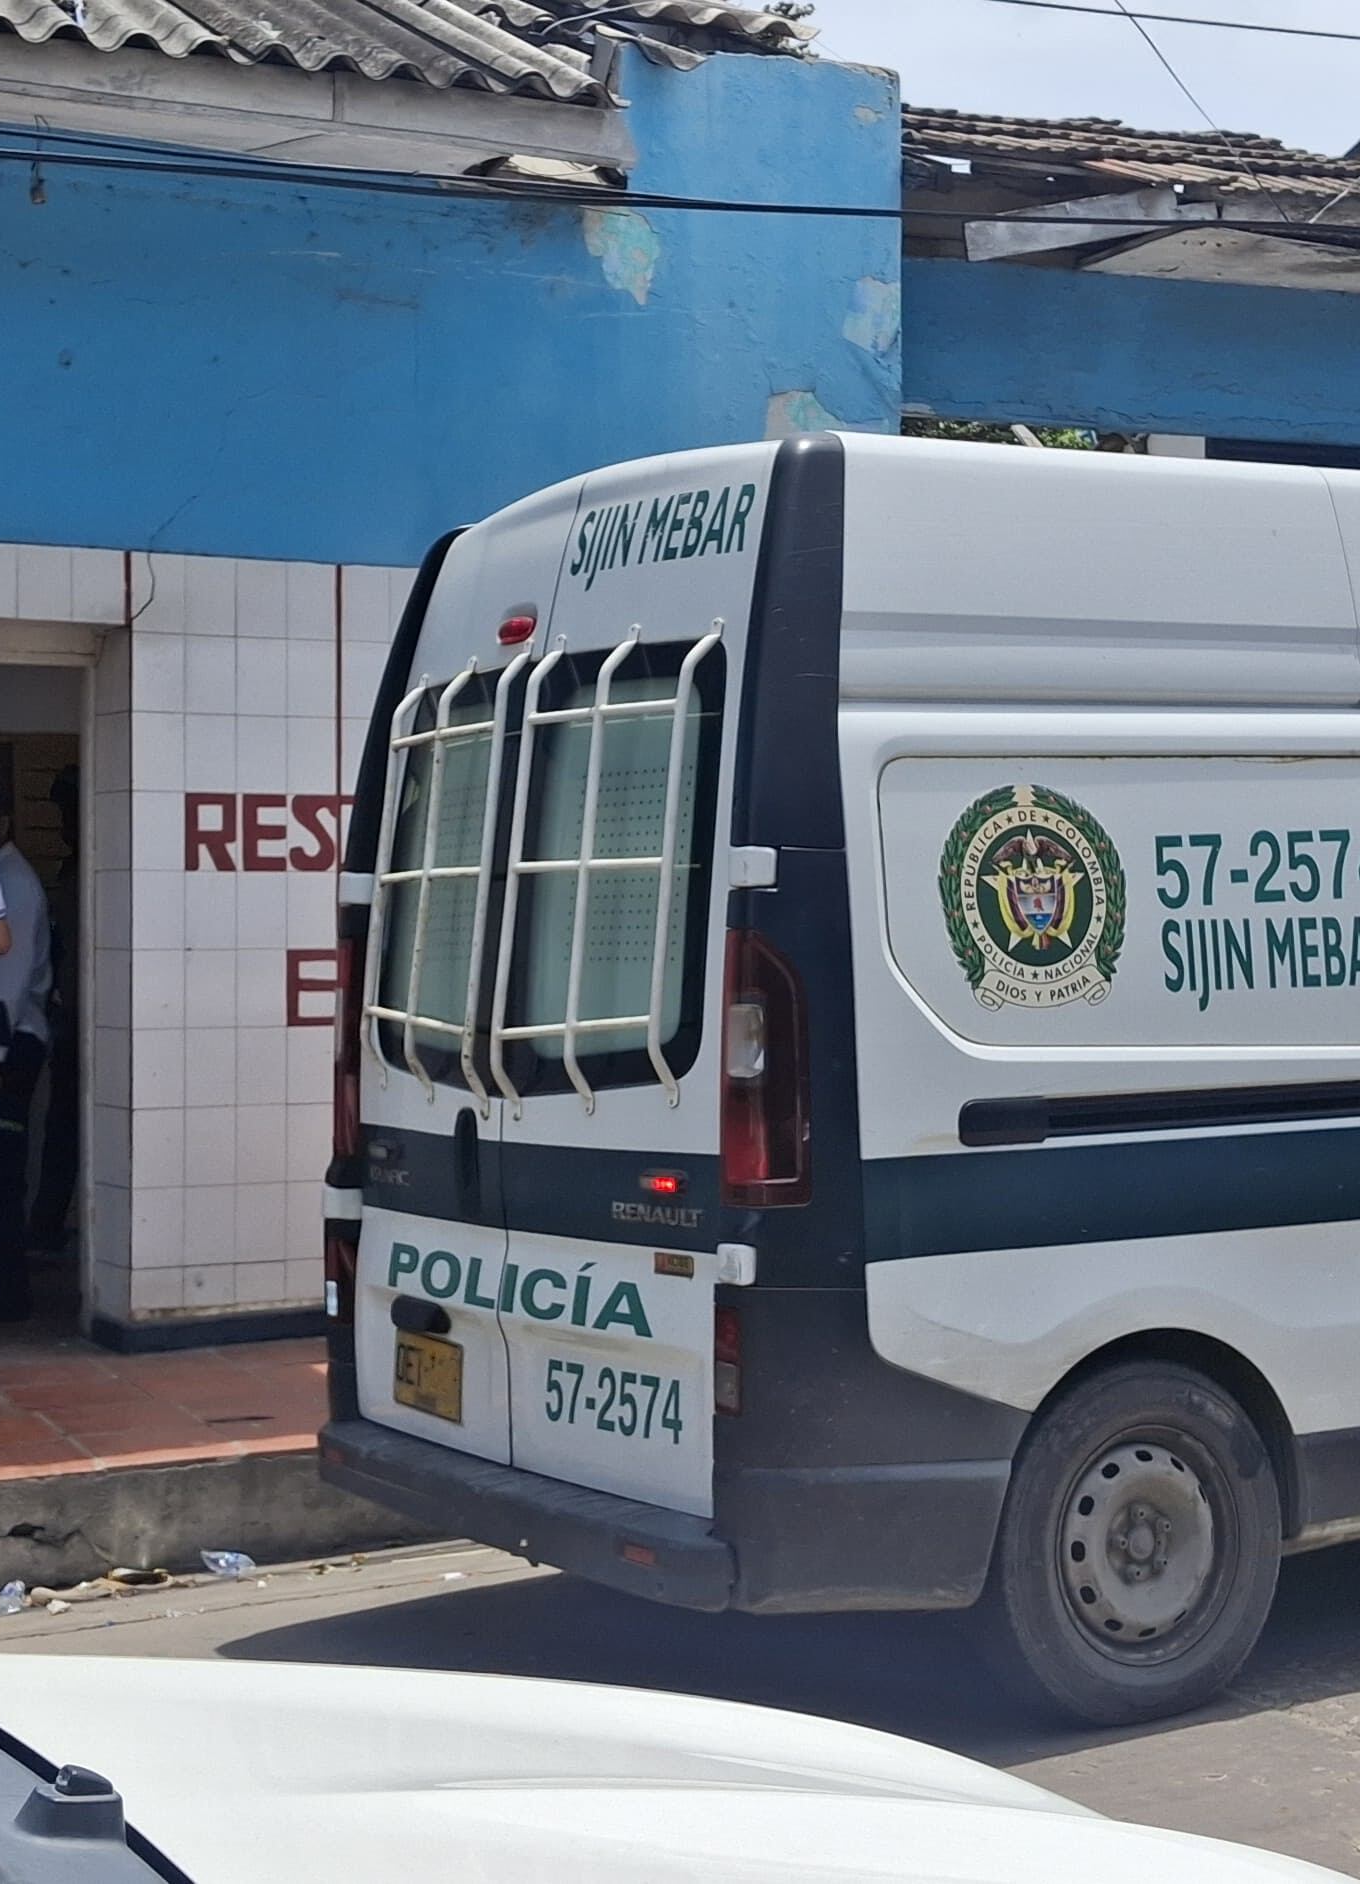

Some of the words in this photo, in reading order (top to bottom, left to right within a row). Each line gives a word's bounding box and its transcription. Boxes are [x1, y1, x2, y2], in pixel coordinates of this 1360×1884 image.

[570, 501, 643, 591] SIJIN
[638, 484, 755, 564] MEBAR
[1018, 810, 1037, 823] DE
[1055, 818, 1106, 907] COLOMBIA
[996, 979, 1027, 1001] DIOS
[1035, 991, 1043, 1004] Y
[1050, 974, 1091, 1000] PATRIA
[1044, 932, 1098, 977] NACIONAL
[1161, 918, 1254, 1012] SIJIN
[612, 1200, 704, 1228] RENAULT
[387, 1242, 654, 1338] POLICÍA
[545, 1359, 683, 1445] 57-2574
